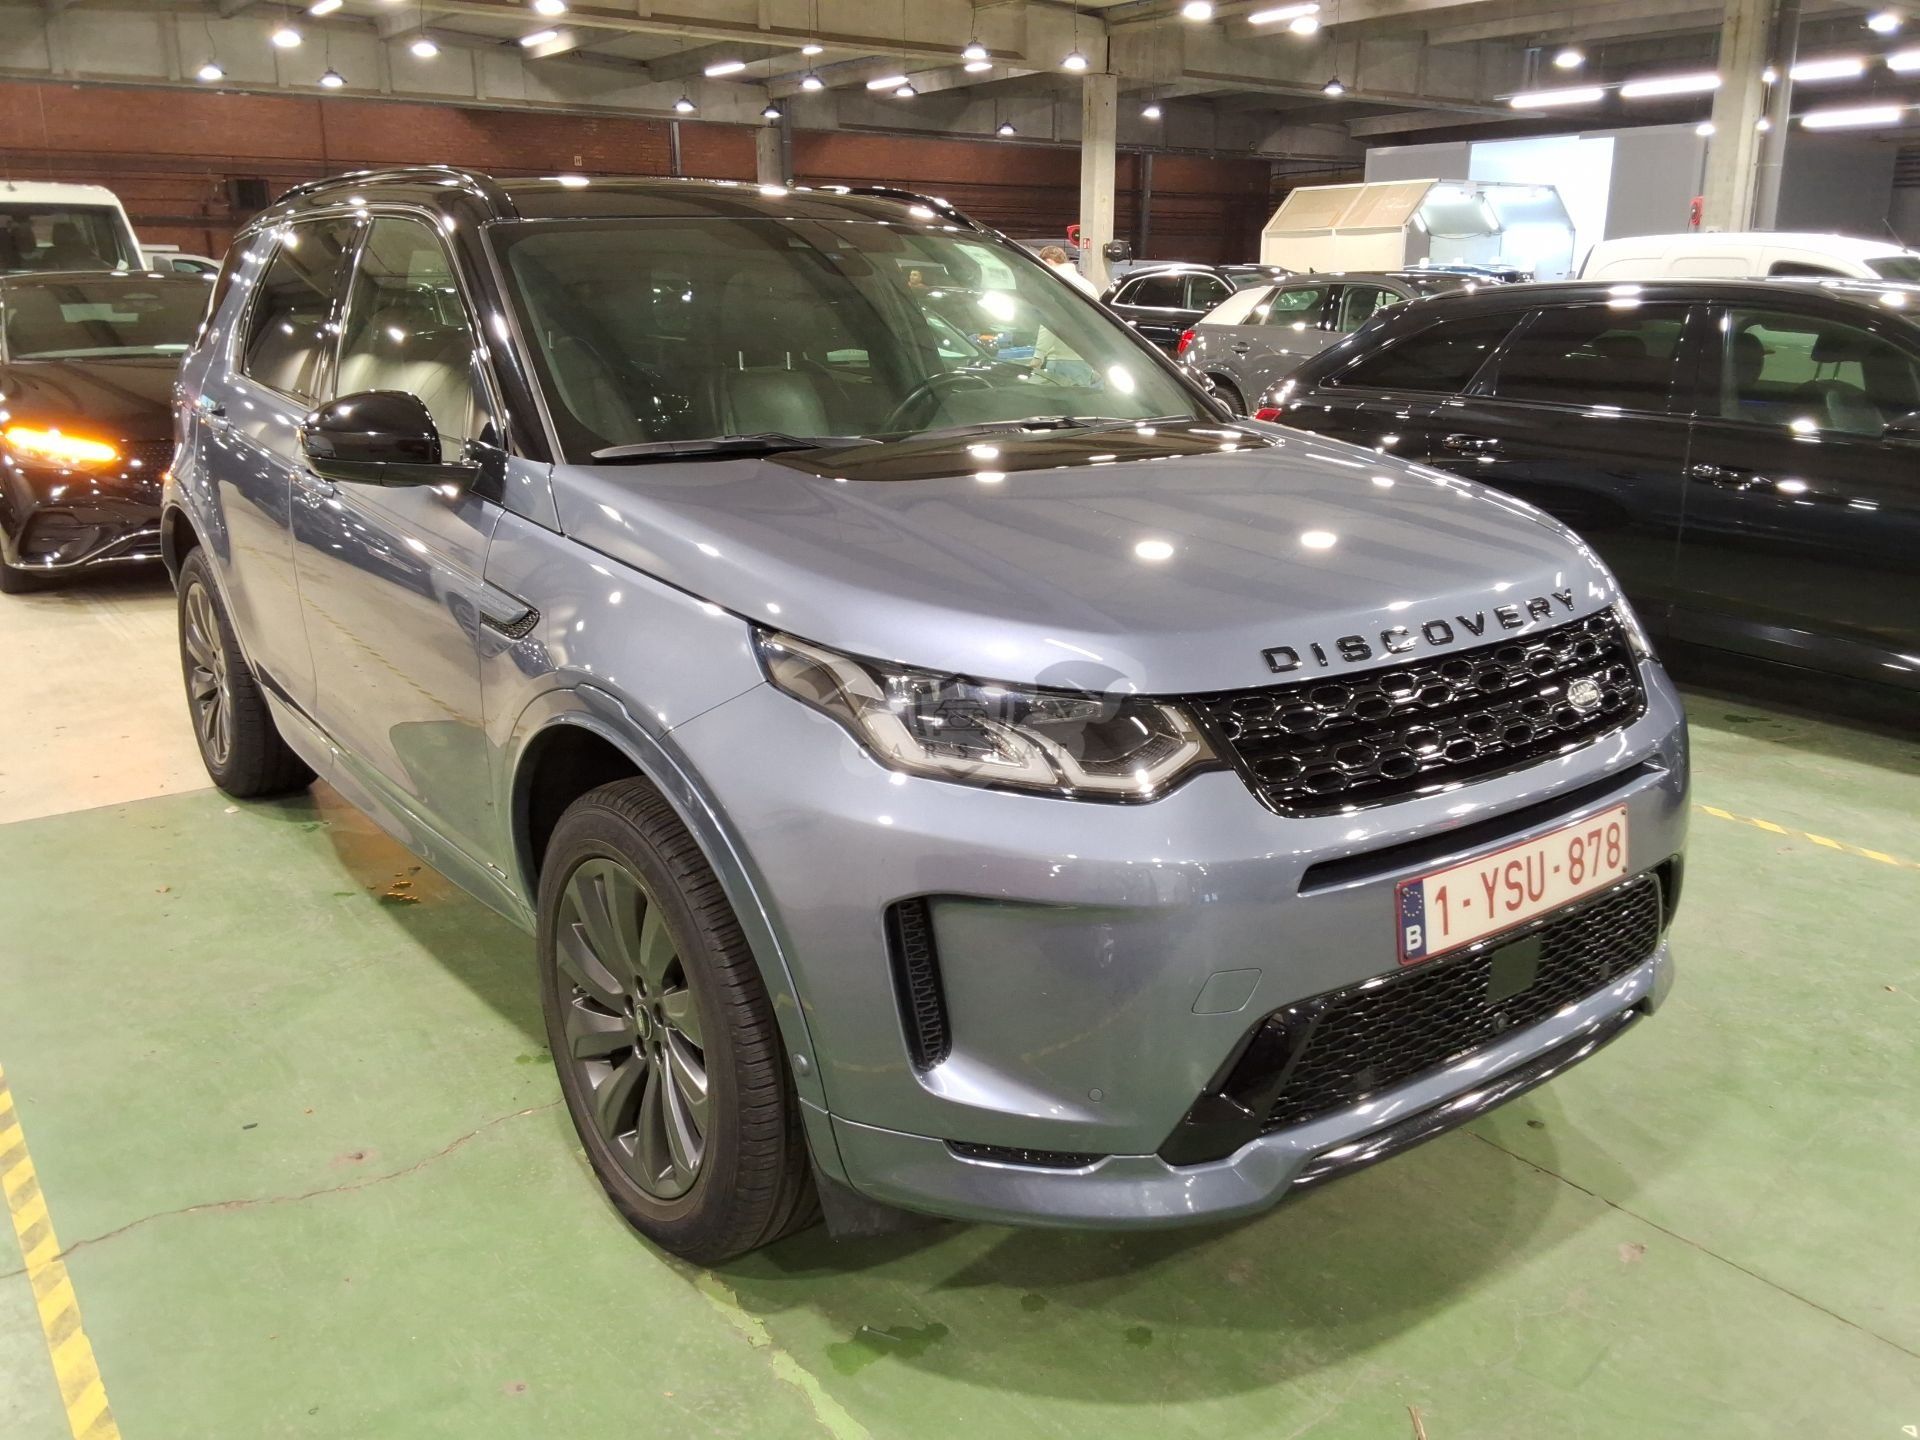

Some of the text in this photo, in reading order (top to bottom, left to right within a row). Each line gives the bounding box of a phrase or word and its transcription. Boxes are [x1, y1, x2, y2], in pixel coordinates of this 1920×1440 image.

[1261, 588, 1575, 674] DISCOVERY
[1434, 822, 1621, 936] 1-YSU-878
[1405, 924, 1422, 951] B
